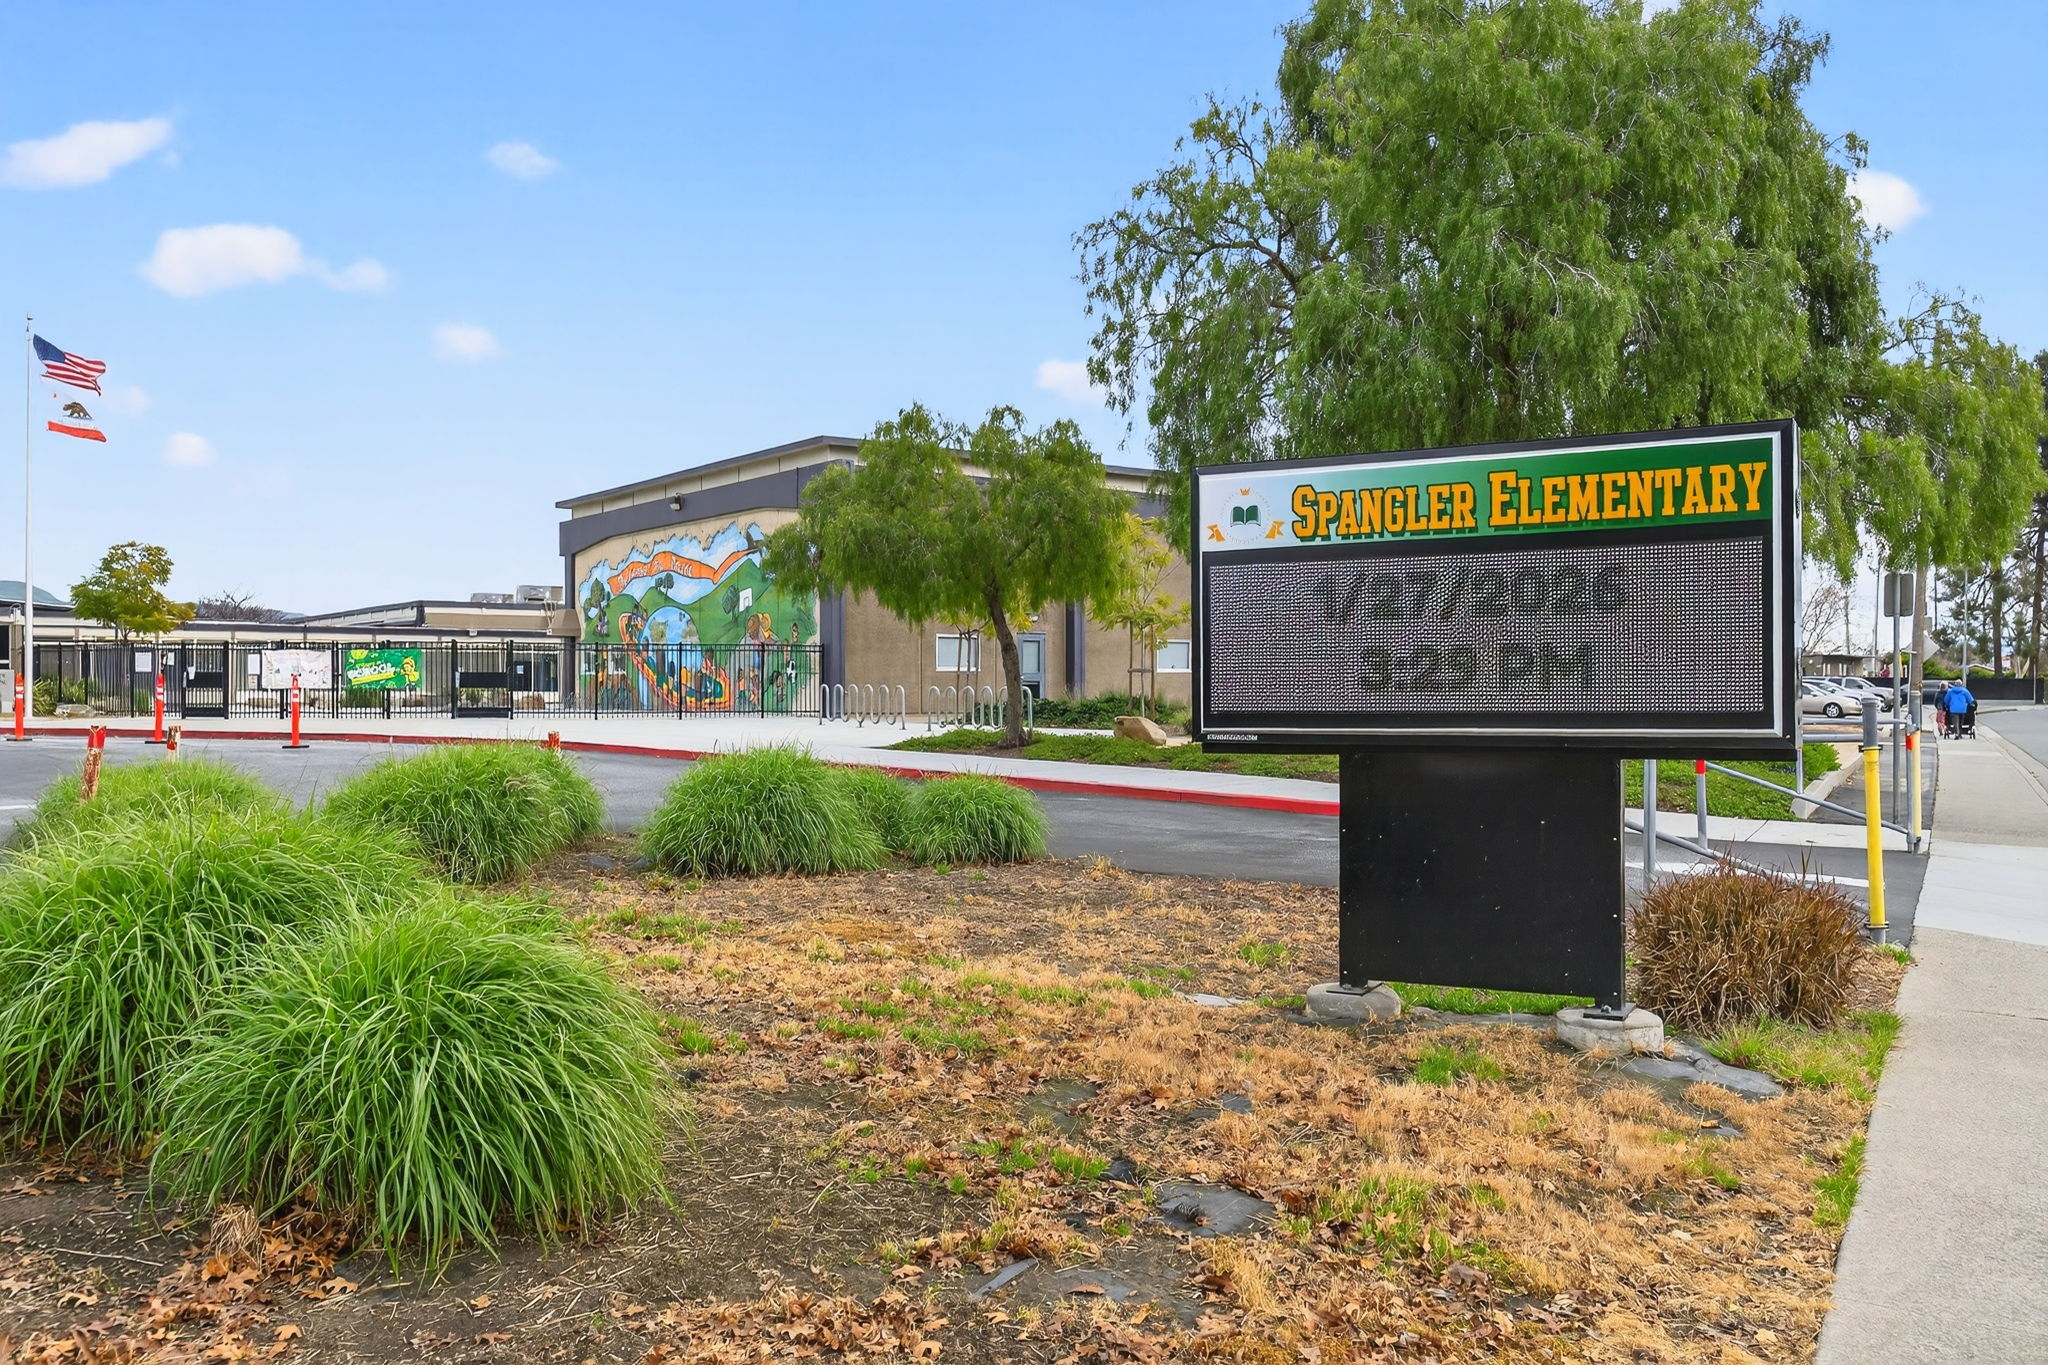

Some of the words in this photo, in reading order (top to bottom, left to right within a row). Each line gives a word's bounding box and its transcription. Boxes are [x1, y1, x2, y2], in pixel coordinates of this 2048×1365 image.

[1292, 484, 1478, 541] SPANGLER
[1488, 461, 1767, 528] ELEMENTARY
[1314, 565, 1627, 624] 1/27/2026
[1359, 645, 1478, 691] 3:29
[1500, 642, 1593, 691] PM
